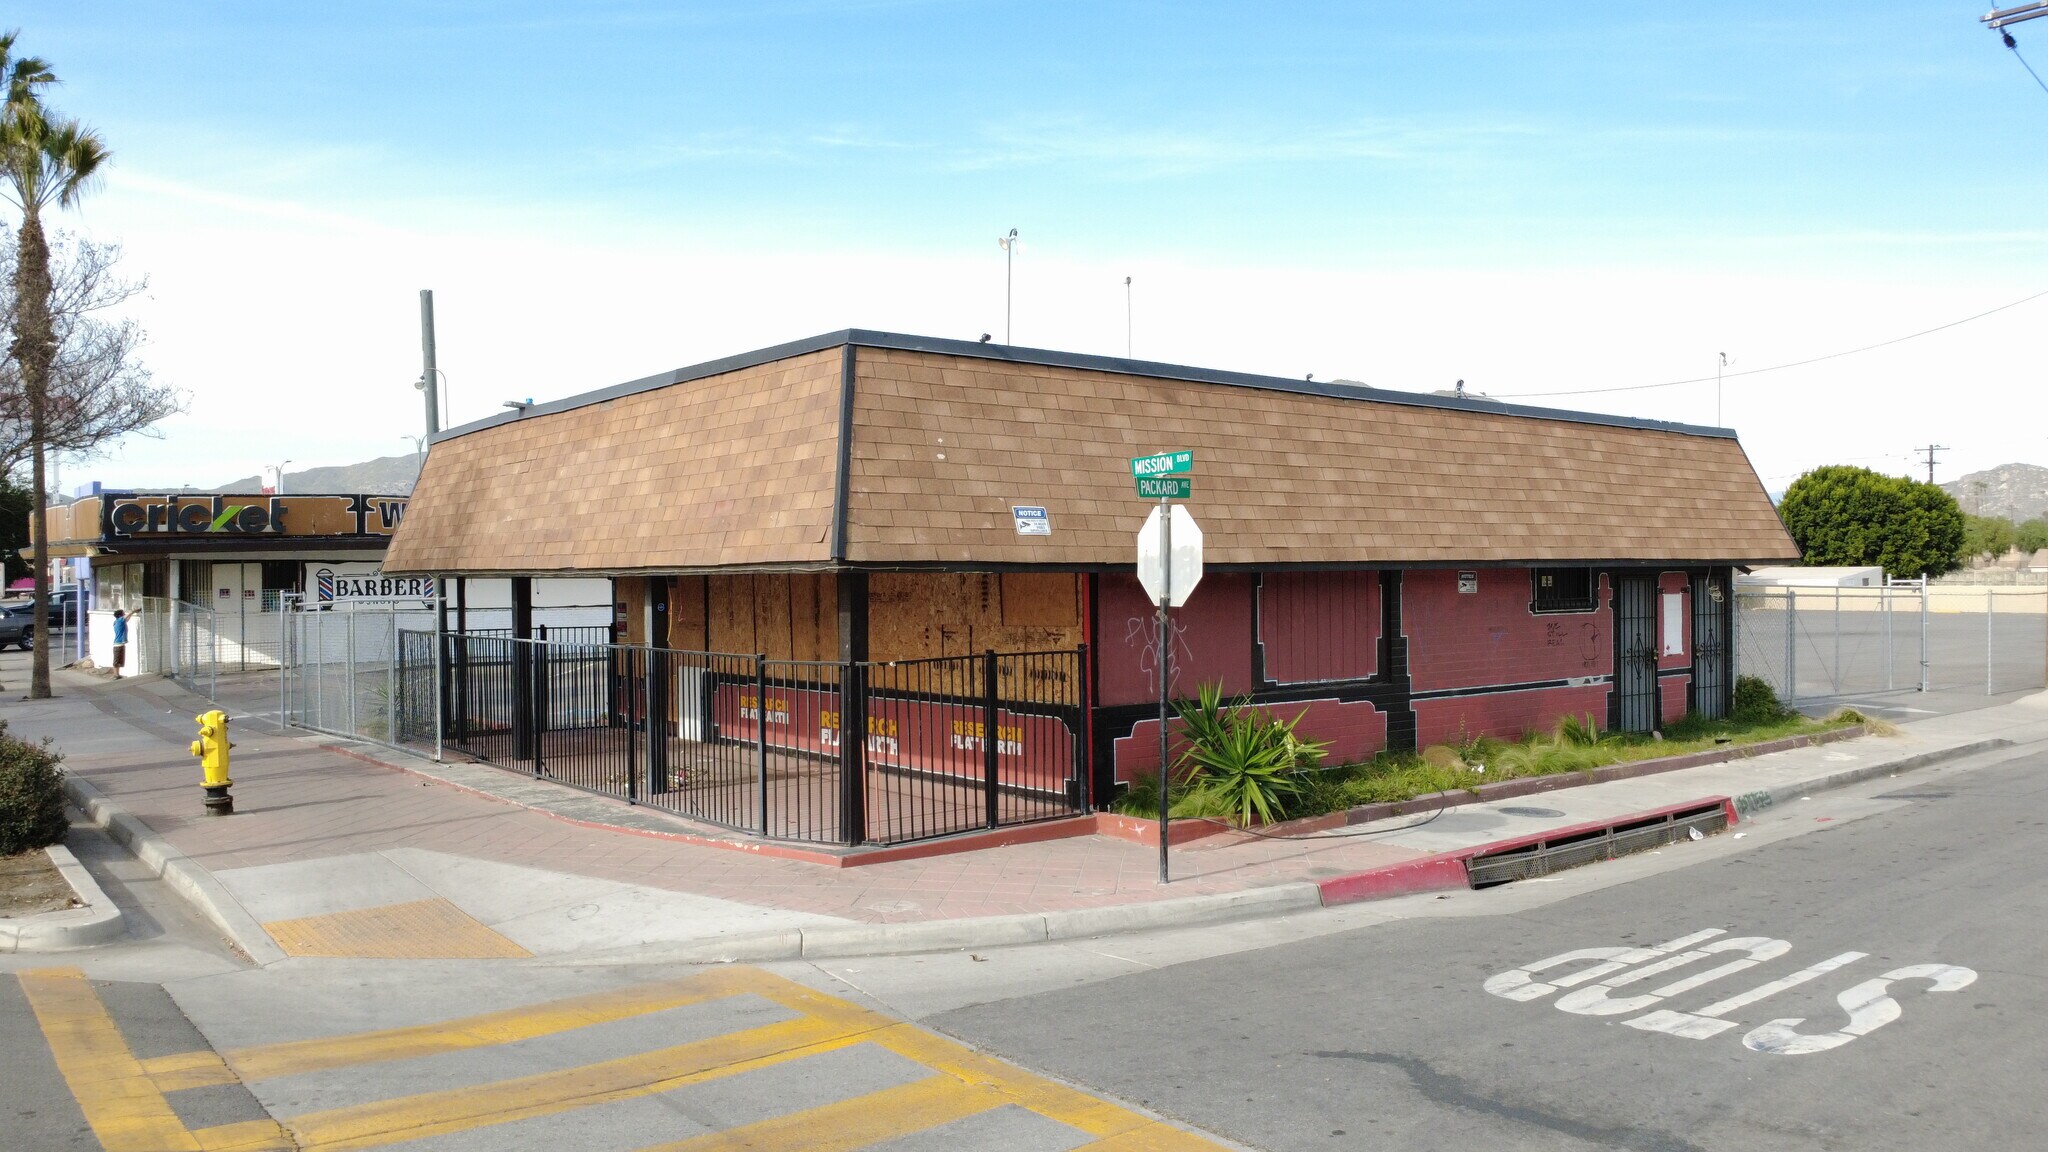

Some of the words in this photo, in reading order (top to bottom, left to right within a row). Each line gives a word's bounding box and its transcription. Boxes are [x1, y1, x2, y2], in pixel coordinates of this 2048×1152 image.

[1134, 455, 1174, 475] MISSION
[1176, 453, 1190, 463] BLVD
[1140, 480, 1179, 495] PACKARD
[1181, 481, 1190, 489] AVE
[111, 494, 288, 533] cricket
[335, 578, 422, 597] BARBER
[1482, 927, 1978, 1055] STOP
